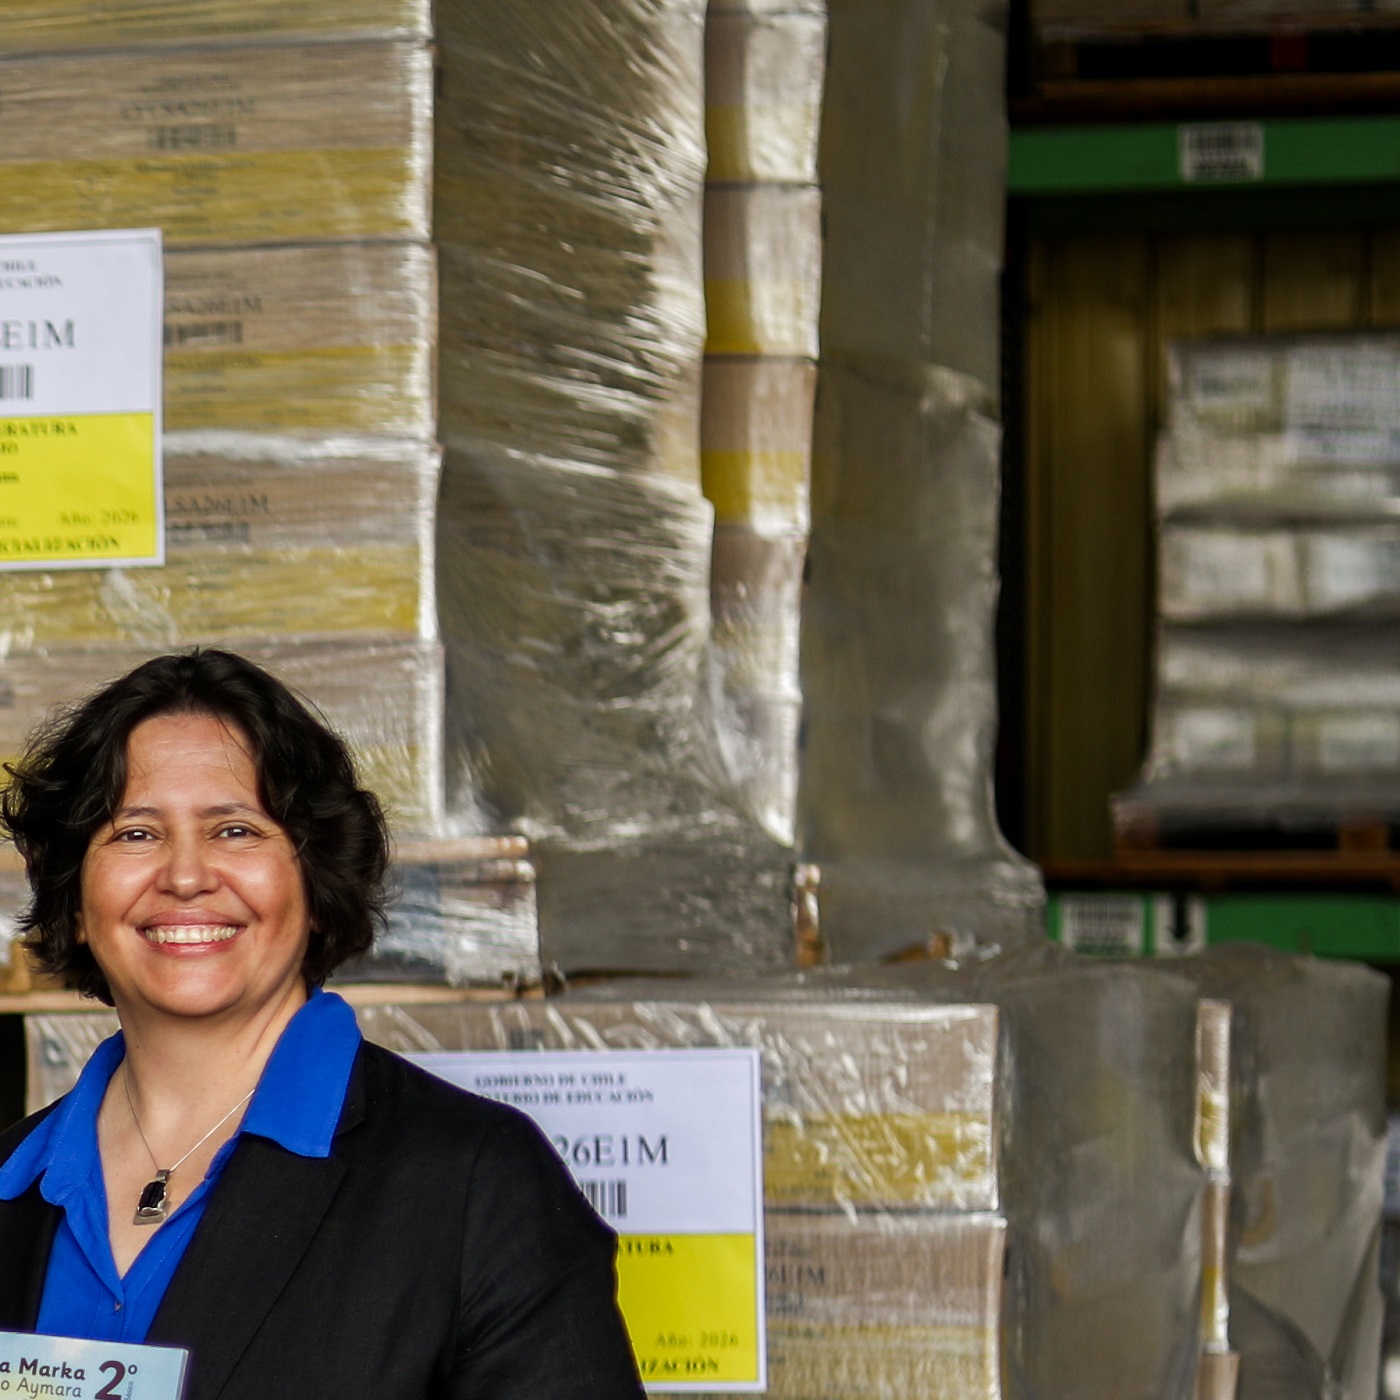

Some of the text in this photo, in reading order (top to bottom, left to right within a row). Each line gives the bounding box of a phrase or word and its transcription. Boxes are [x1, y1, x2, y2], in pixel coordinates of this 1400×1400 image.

[581, 1071, 625, 1086] CHILE
[553, 1133, 670, 1167] 26E1M
[18, 1357, 86, 1380] Marka
[16, 1377, 82, 1399] Aymara
